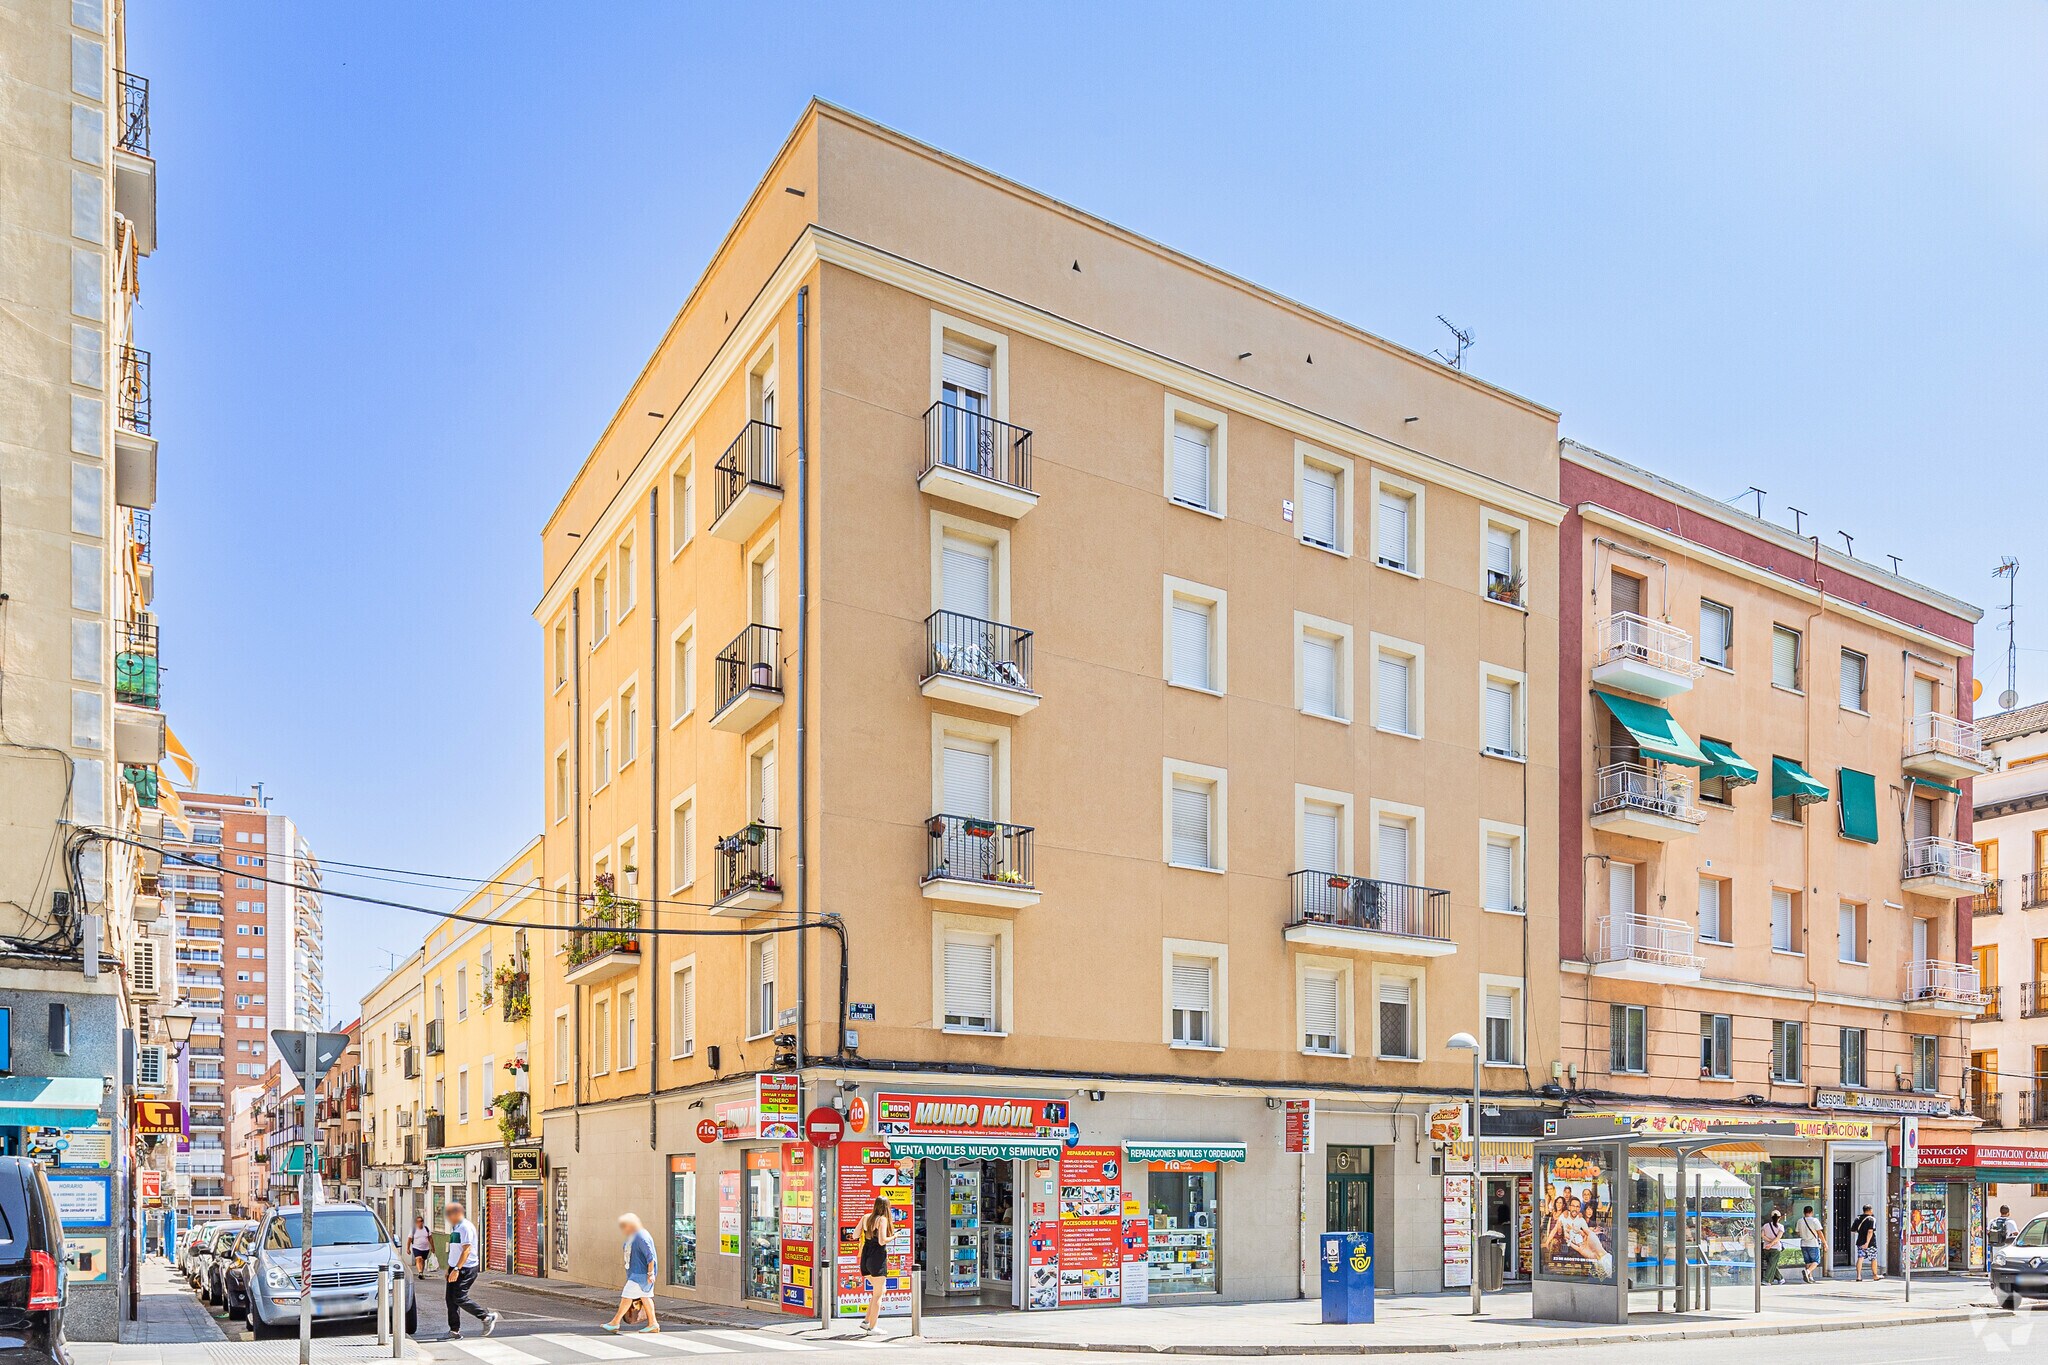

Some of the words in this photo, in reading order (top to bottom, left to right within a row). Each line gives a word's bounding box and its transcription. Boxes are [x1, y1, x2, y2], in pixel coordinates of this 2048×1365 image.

[1818, 1094, 1846, 1105] ASESORIA
[1872, 1097, 1916, 1110] ADMINISTRACION
[1919, 1101, 1926, 1110] DE
[1928, 1101, 1946, 1111] FINCAS
[851, 1102, 863, 1120] ria
[915, 1102, 979, 1126] MUNDO
[982, 1101, 1033, 1127] MÓVIL
[699, 1122, 715, 1135] ria
[1794, 1122, 1859, 1136] ALIMENTACIÓN
[895, 1145, 924, 1155] VENTA
[926, 1146, 965, 1155] MOVILES
[969, 1147, 998, 1156] NUEVO
[1001, 1147, 1007, 1156] Y
[1009, 1147, 1058, 1156] SEMINUEVO
[1976, 1150, 2024, 1158] ALIMENTACION
[1165, 1161, 1179, 1170] ria
[1341, 1156, 1345, 1165] 5
[1552, 1166, 1600, 1178] VERANO
